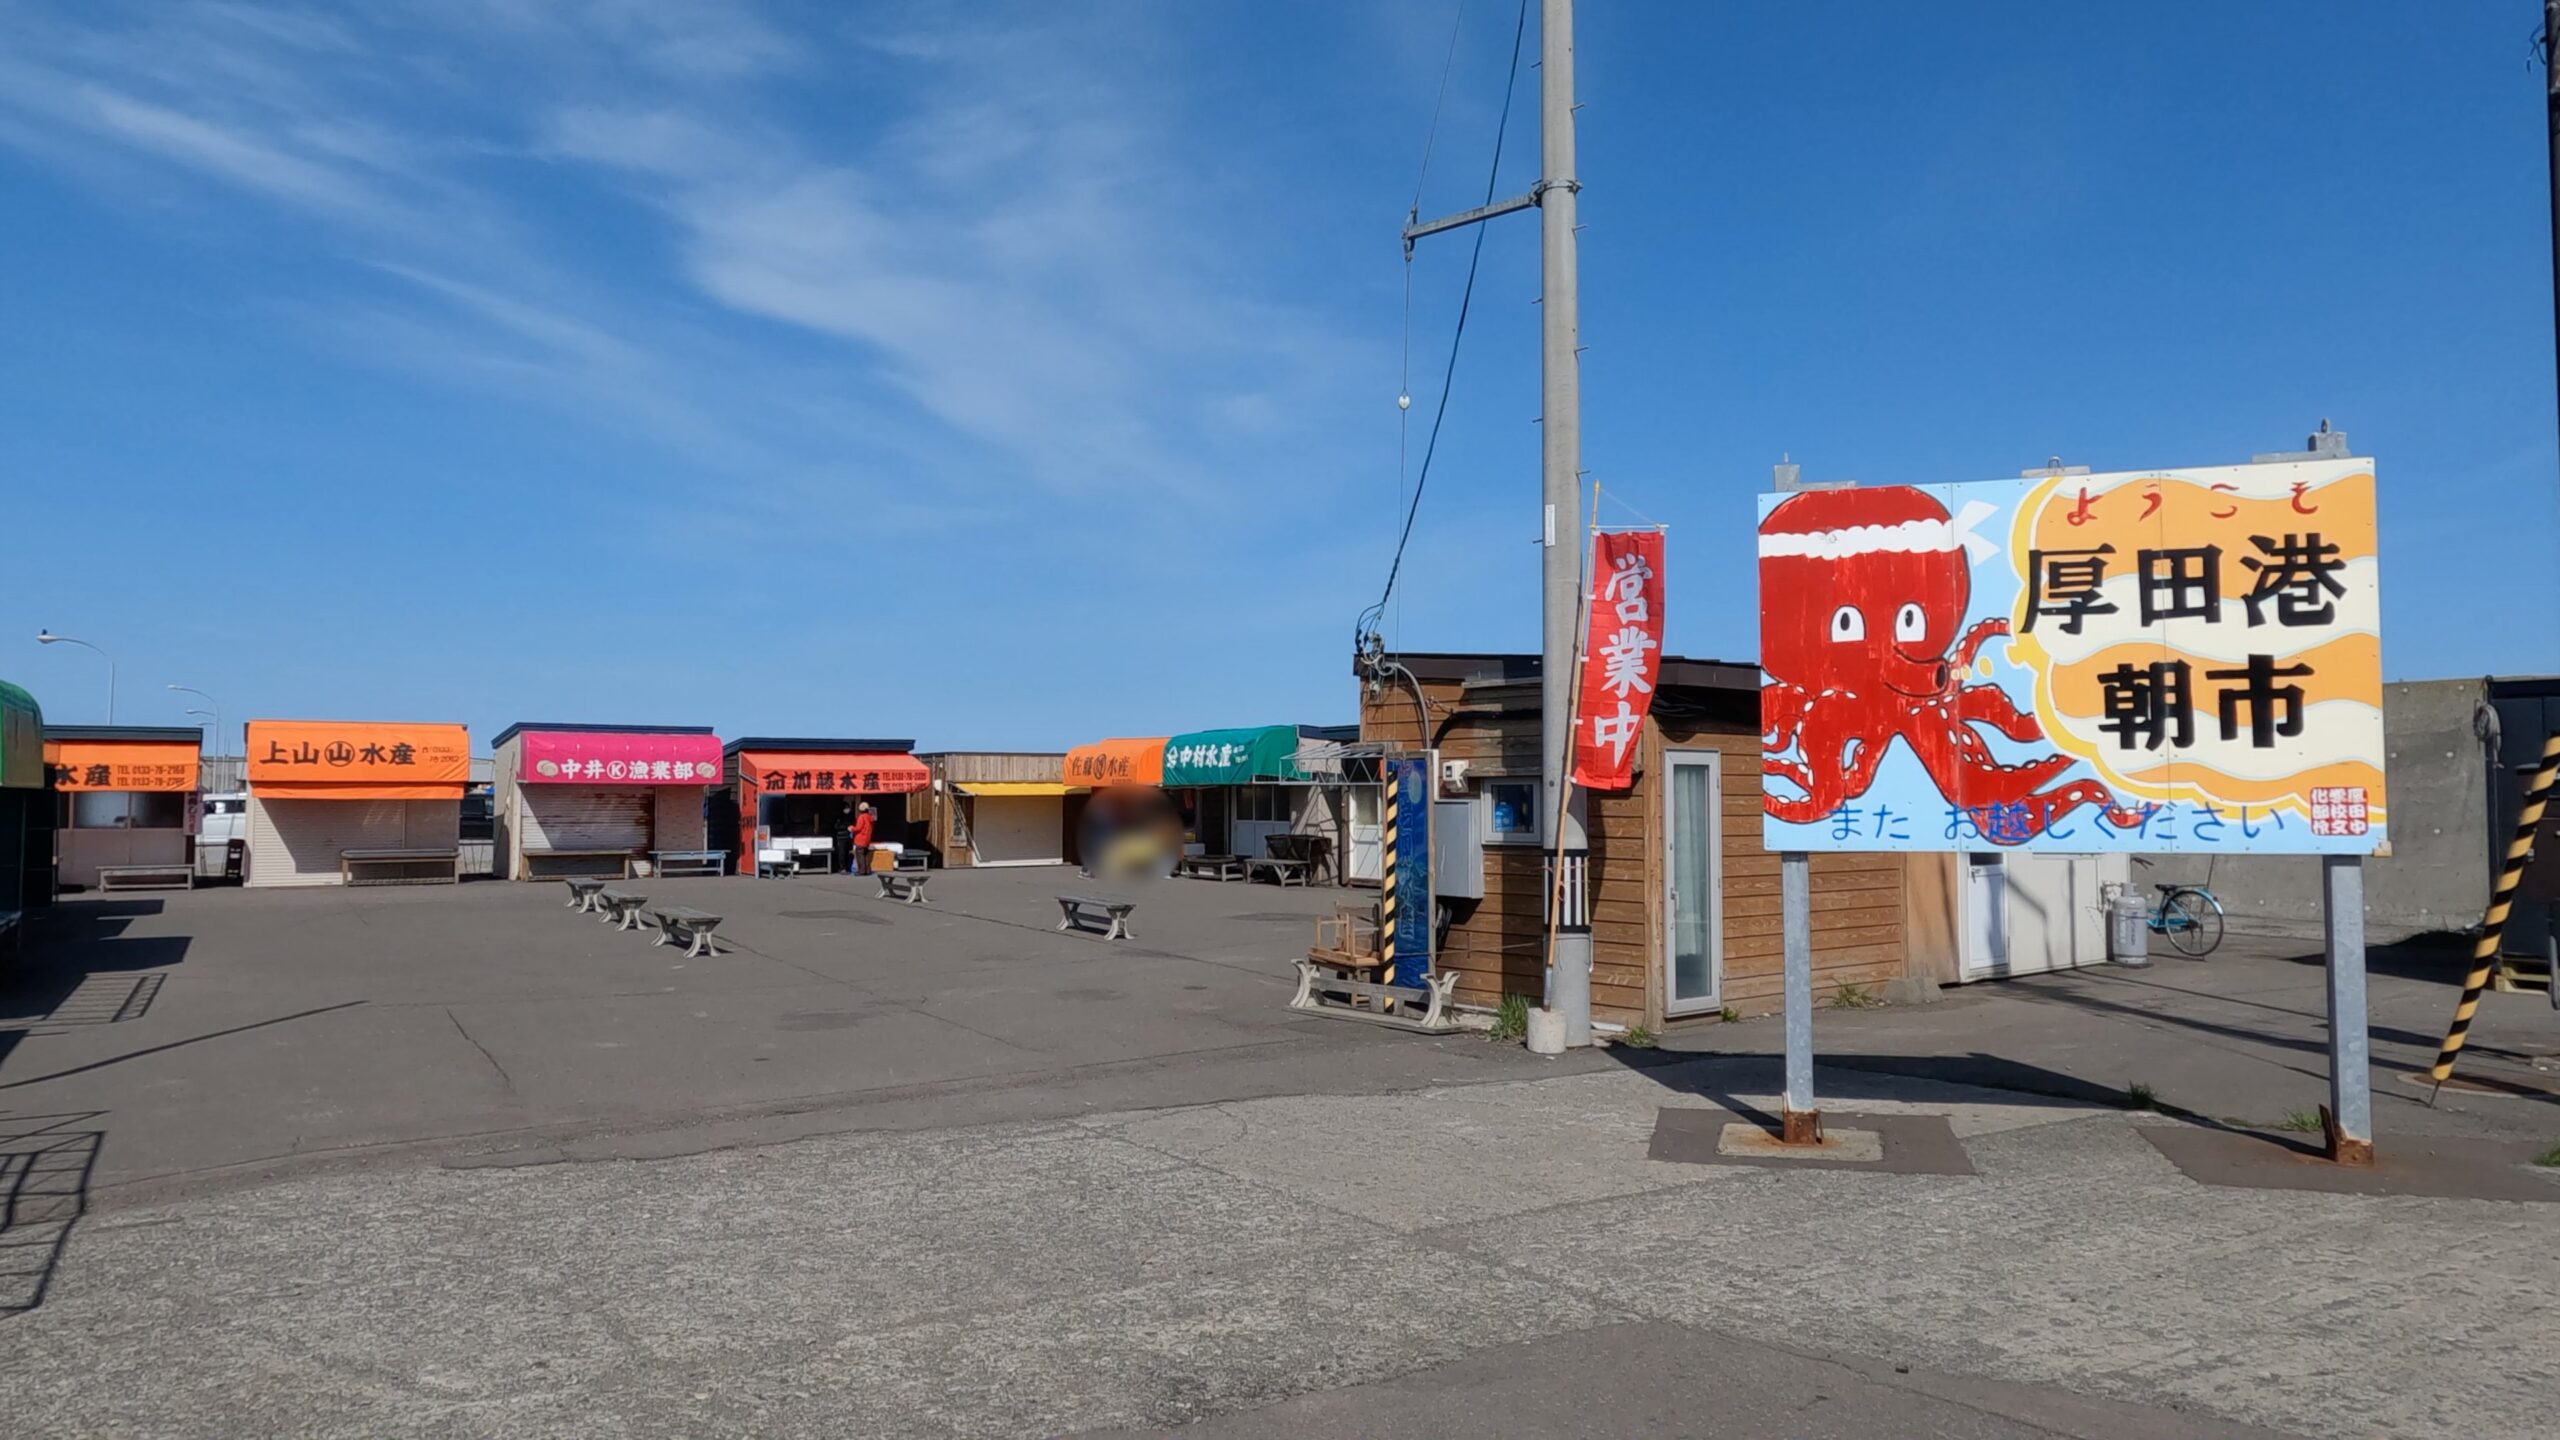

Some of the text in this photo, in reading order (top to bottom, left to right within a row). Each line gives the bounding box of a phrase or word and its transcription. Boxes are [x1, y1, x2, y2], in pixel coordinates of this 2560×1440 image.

[2066, 481, 2319, 526] ようこそ
[2018, 532, 2348, 635] 厚田港
[1594, 552, 1657, 769] 営業中
[2097, 653, 2315, 751] 朝市
[1830, 801, 2286, 842] また お越しください
